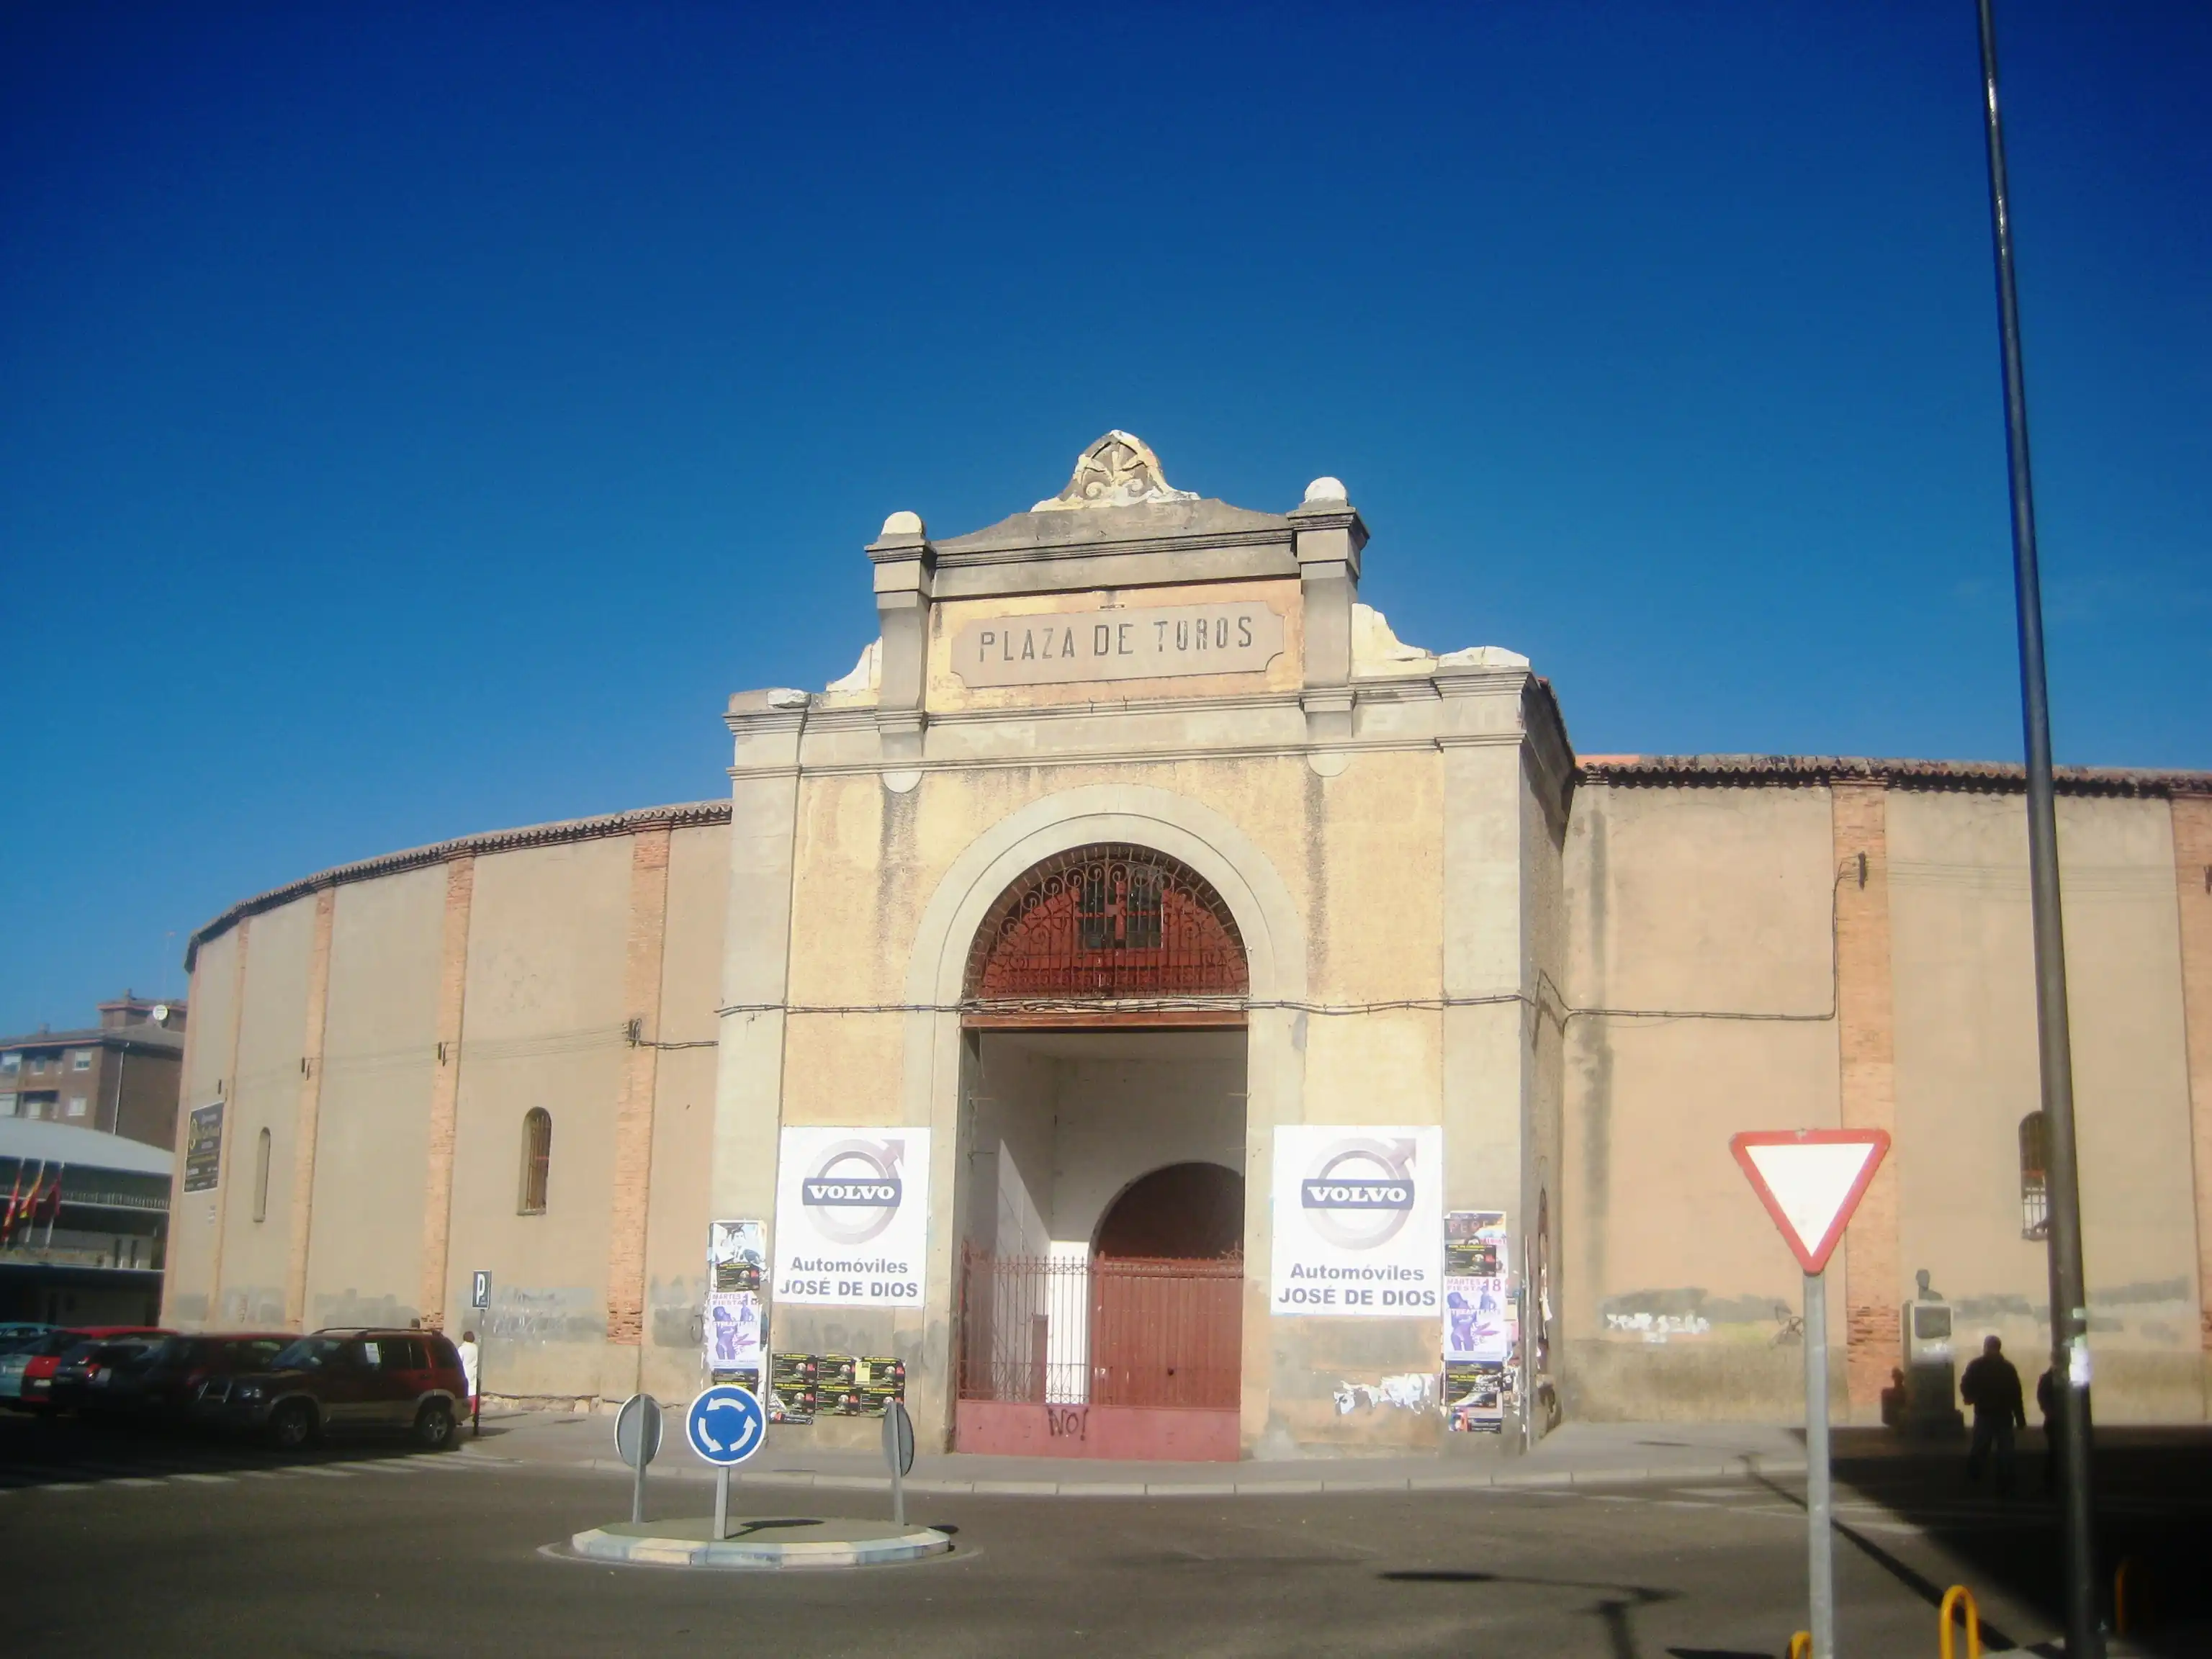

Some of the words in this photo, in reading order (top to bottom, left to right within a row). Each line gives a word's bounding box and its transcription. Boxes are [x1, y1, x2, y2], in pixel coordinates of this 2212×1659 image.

[979, 626, 1076, 662] PLAZA
[1093, 623, 1134, 657] DE
[1154, 616, 1253, 653] TOROS
[807, 1184, 896, 1200] VOLVO
[1307, 1186, 1408, 1202] VOLVO
[791, 1256, 909, 1274] Automóviles
[1290, 1263, 1425, 1281] Automóviles
[476, 1272, 485, 1305] P
[779, 1277, 831, 1295] JOSÉ
[837, 1281, 864, 1296] DE
[871, 1282, 919, 1298] DIOS
[1277, 1285, 1336, 1305] JOSÉ
[1344, 1289, 1374, 1305] DE
[1382, 1290, 1437, 1306] DIOS
